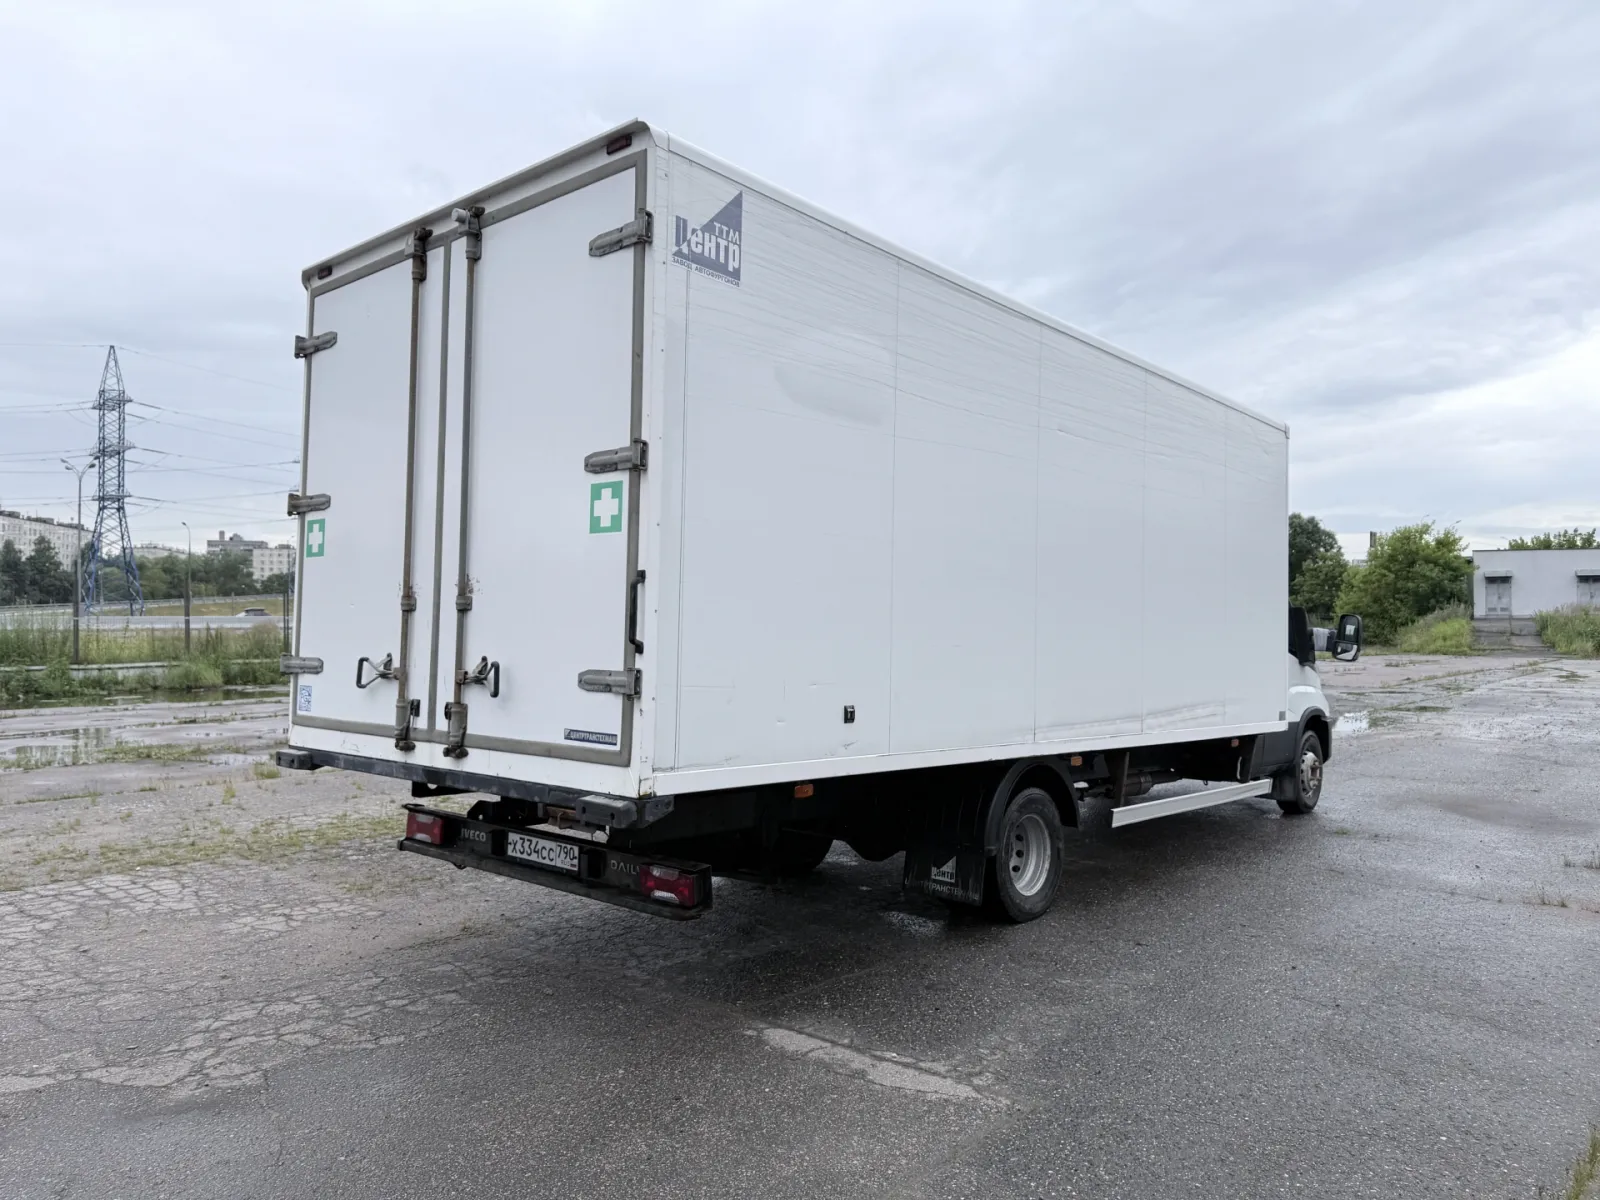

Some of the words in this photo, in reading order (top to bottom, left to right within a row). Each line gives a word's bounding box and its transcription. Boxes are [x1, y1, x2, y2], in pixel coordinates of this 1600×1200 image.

[713, 221, 740, 244] ТТМ
[671, 257, 692, 271] ЗАВОД
[695, 266, 740, 287] АВТОФУРГОНОВ
[461, 828, 486, 841] IVECO
